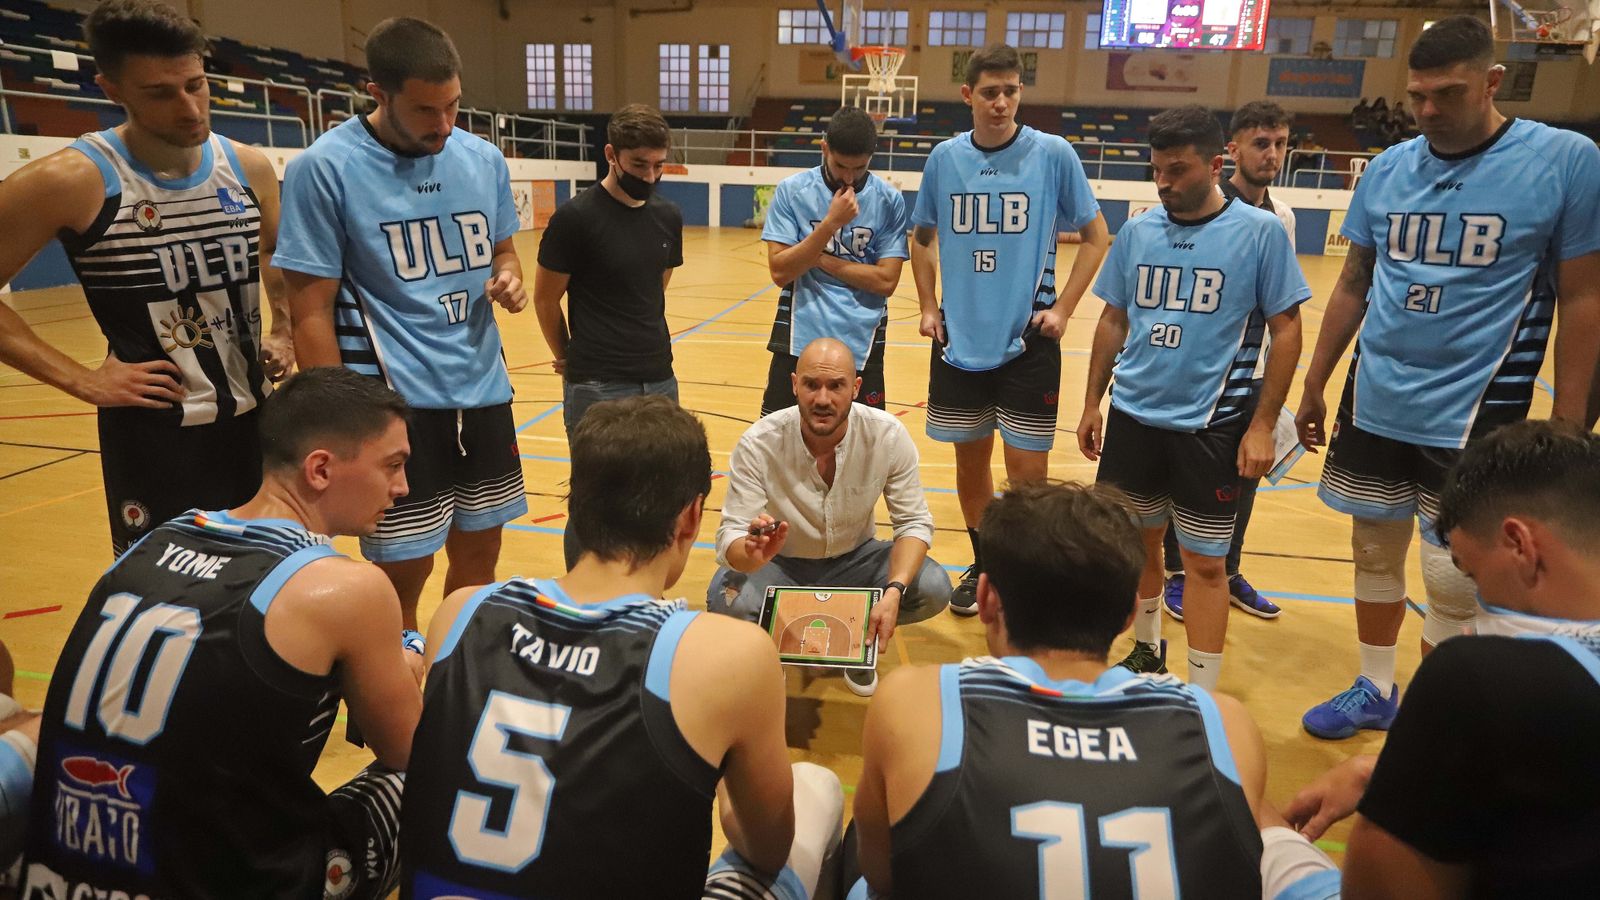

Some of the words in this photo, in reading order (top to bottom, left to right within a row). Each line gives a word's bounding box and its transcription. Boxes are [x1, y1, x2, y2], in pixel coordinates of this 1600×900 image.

[1209, 33, 1228, 46] 47
[224, 204, 242, 213] EBA
[417, 182, 442, 194] vive
[950, 192, 1030, 235] ULB
[379, 210, 493, 282] ULB
[972, 250, 997, 272] 15
[1173, 240, 1195, 250] vive
[1386, 212, 1507, 268] ULB
[152, 234, 249, 293] ULB
[438, 290, 469, 325] 17
[1135, 264, 1225, 314] ULB
[1404, 283, 1443, 314] 21
[1150, 323, 1182, 349] 20
[156, 541, 232, 580] YOME
[64, 592, 203, 745] 10
[511, 622, 600, 676] TAVIO
[1027, 719, 1137, 761] EGEA
[448, 689, 572, 873] 5
[1010, 800, 1181, 900] 11
